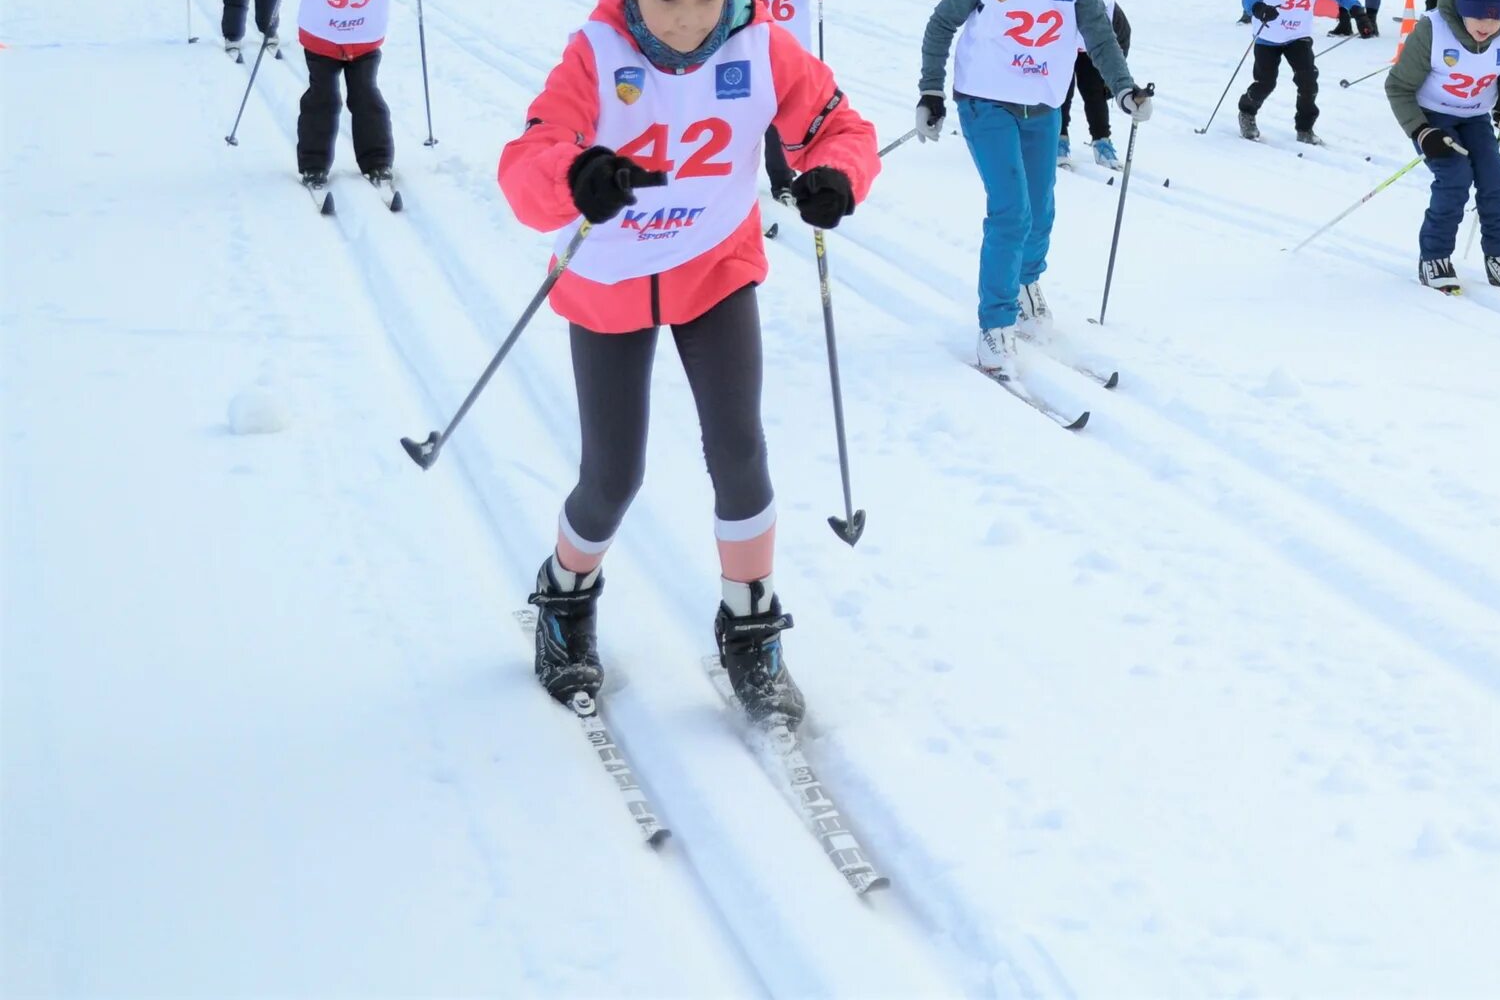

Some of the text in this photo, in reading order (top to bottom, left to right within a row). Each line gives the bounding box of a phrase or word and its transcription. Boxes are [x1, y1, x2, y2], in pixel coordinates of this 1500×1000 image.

[1004, 10, 1063, 47] 22
[615, 117, 733, 180] 42
[637, 230, 679, 241] SPORT
